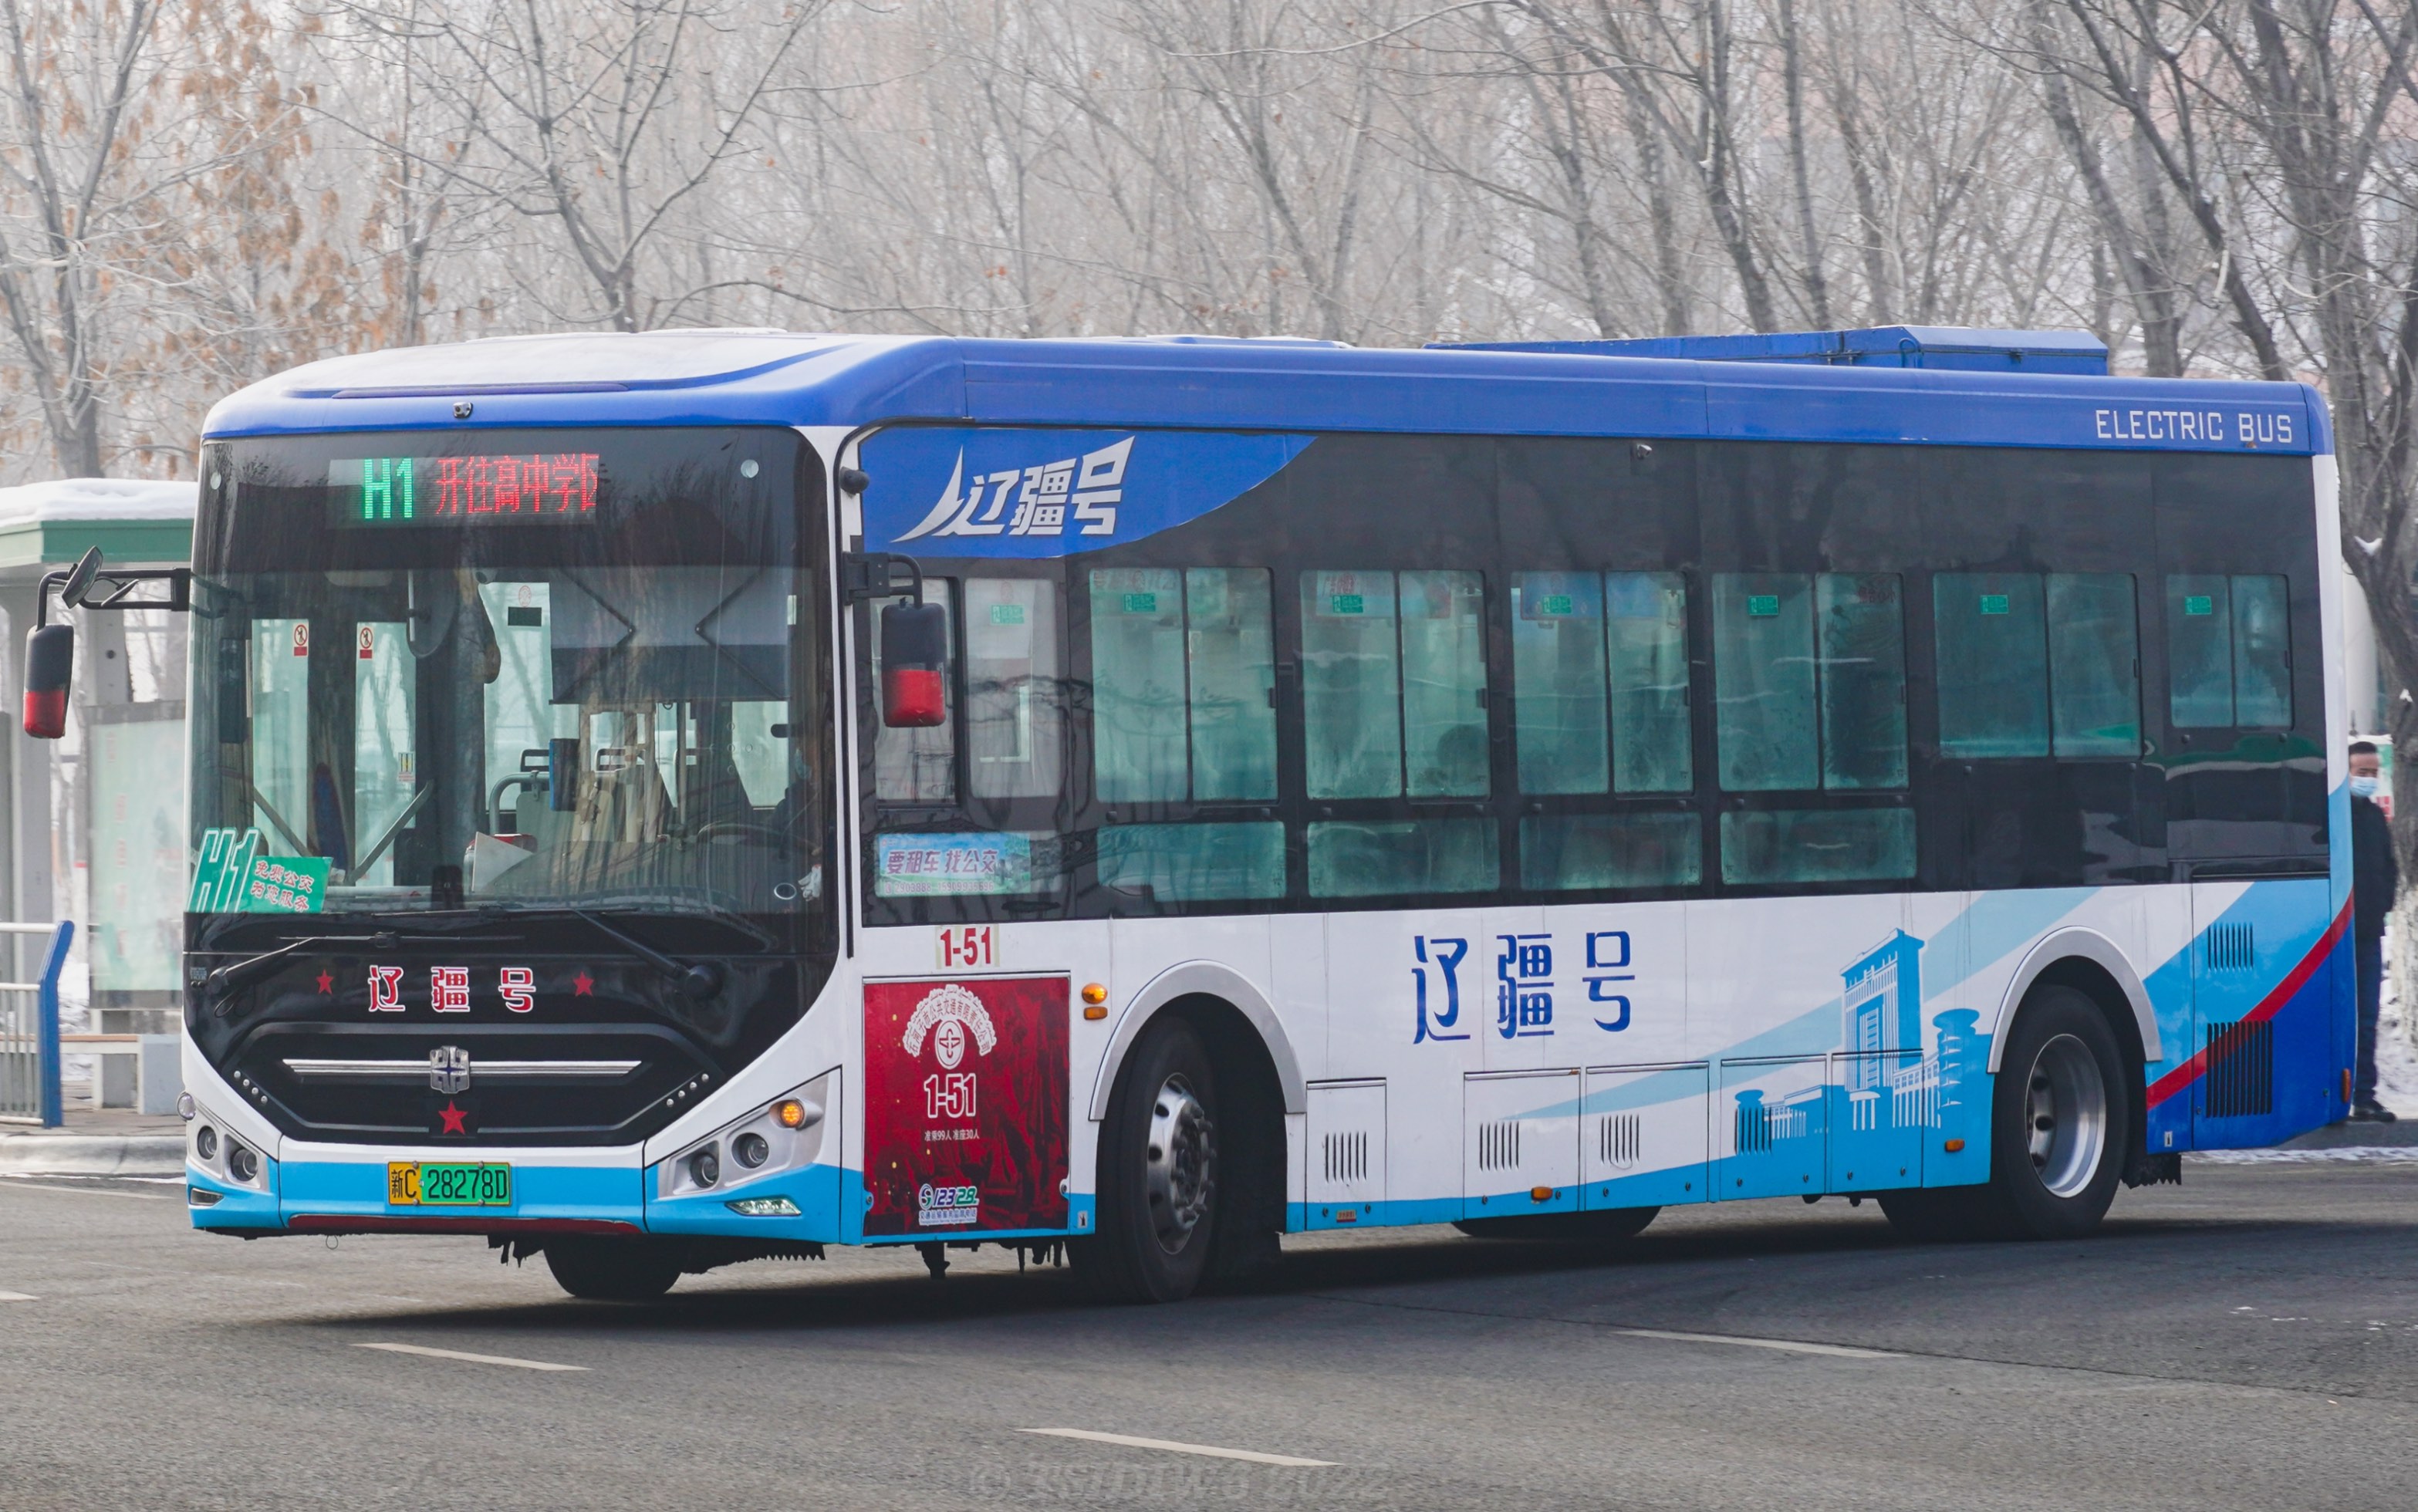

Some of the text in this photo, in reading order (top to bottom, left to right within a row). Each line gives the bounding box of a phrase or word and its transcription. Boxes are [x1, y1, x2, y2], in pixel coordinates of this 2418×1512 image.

[2095, 410, 2293, 444] ELECTRIC BUS
[364, 457, 414, 519] H1
[918, 436, 1136, 538] 辽疆号
[187, 826, 260, 913] H1
[255, 859, 315, 893] 免费公交
[887, 849, 998, 875] 要租车 找公交
[250, 881, 310, 913] 为您服务
[940, 926, 991, 967] 1-51
[368, 964, 537, 1013] 辽疆号
[1411, 930, 1636, 1045] 辽疆号
[924, 1072, 977, 1119] 1-51
[391, 1169, 508, 1200] 新C 28278D
[934, 1187, 978, 1206] 12328
